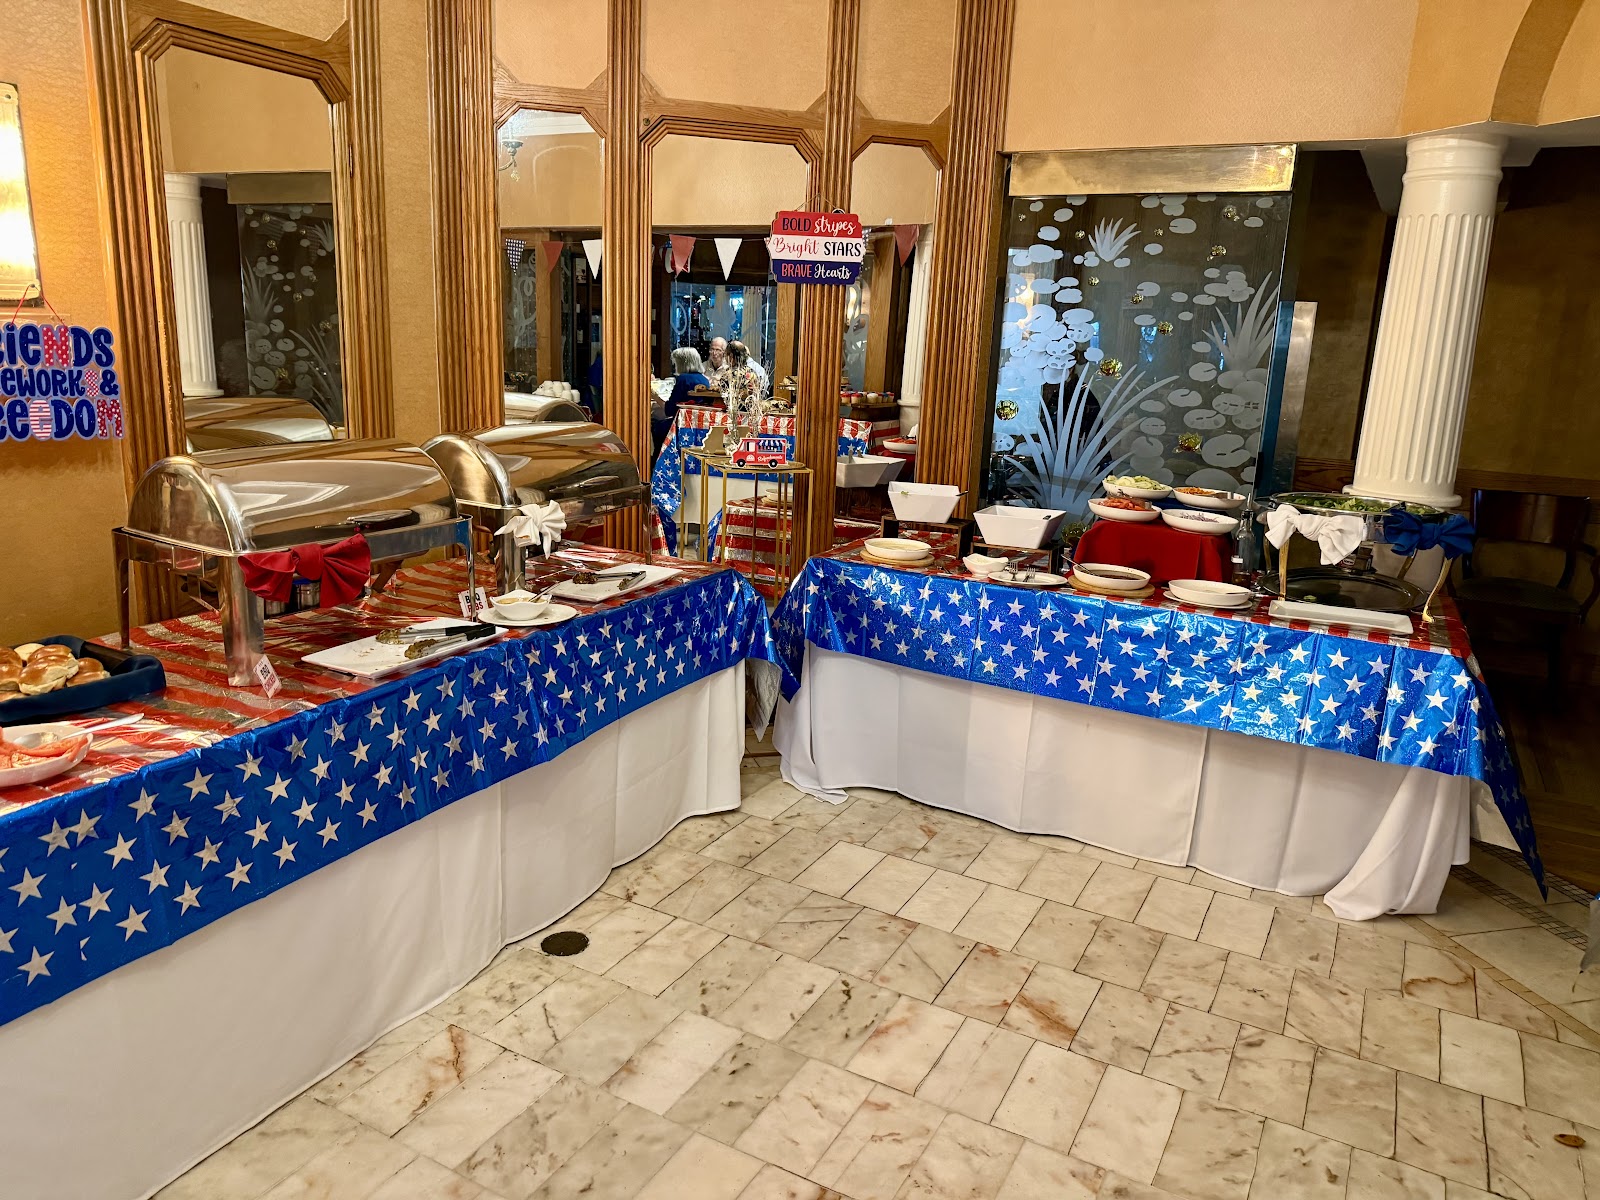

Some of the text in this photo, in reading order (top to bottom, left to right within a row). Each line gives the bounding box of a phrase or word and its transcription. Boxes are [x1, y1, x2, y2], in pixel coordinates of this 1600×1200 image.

[782, 215, 857, 237] BOLD stripes
[773, 237, 862, 259] Bright STARS
[781, 263, 852, 280] BRAVE Hearts
[100, 369, 119, 396] &
[465, 592, 481, 604] BQ
[467, 601, 484, 613] RBS
